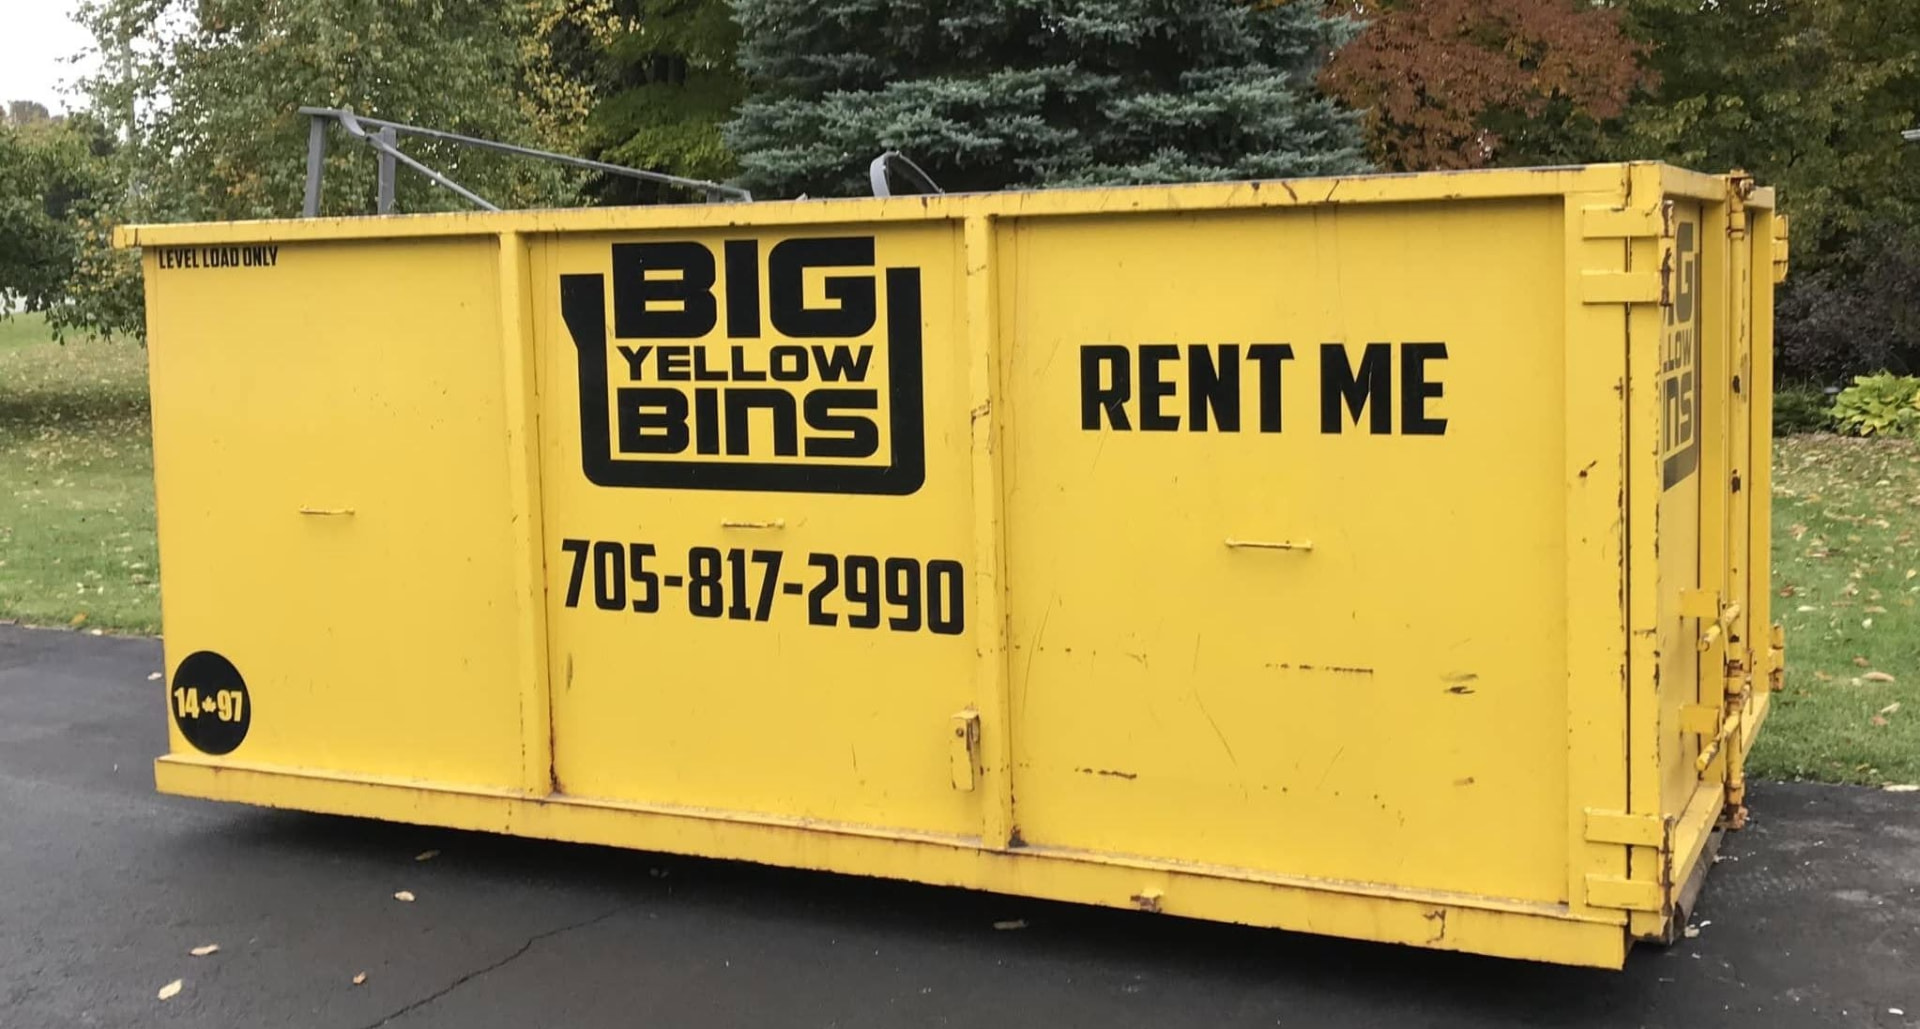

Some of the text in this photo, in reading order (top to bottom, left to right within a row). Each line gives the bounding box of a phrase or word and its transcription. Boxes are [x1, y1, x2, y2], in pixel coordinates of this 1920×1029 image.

[159, 245, 278, 269] LEVEL LOAD ONLY
[611, 236, 877, 338] BIG
[617, 345, 874, 382] YELLOW
[1080, 342, 1449, 436] RENT ME
[561, 538, 965, 636] 705-817-2990
